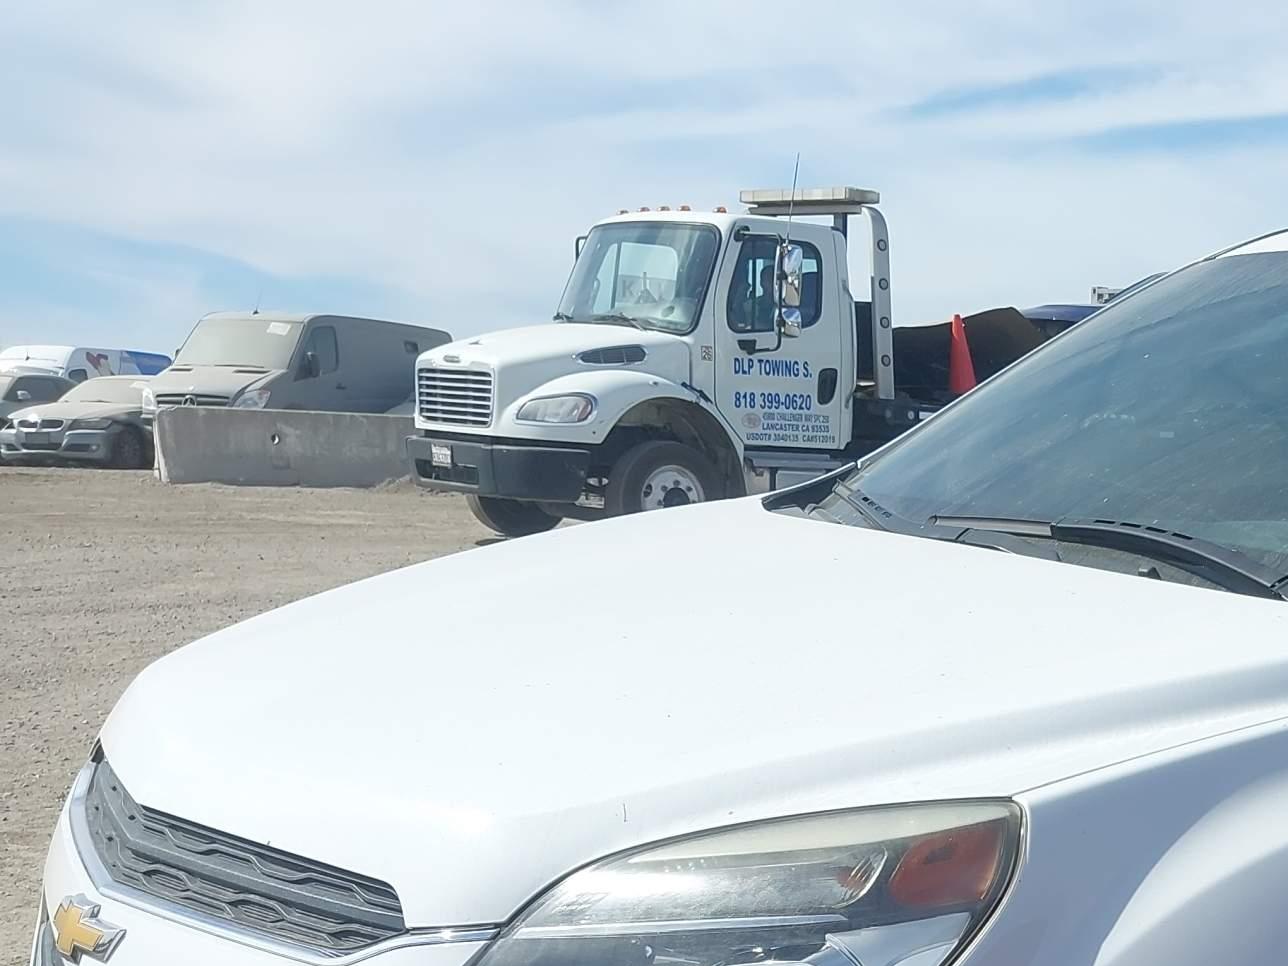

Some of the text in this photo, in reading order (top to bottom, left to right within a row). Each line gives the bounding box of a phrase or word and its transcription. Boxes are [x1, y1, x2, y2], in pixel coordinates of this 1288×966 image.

[733, 357, 813, 378] DLP TOWING S.
[734, 391, 812, 411] 818 399-0620
[762, 422, 800, 432] LANCASTER
[801, 424, 810, 433] CA
